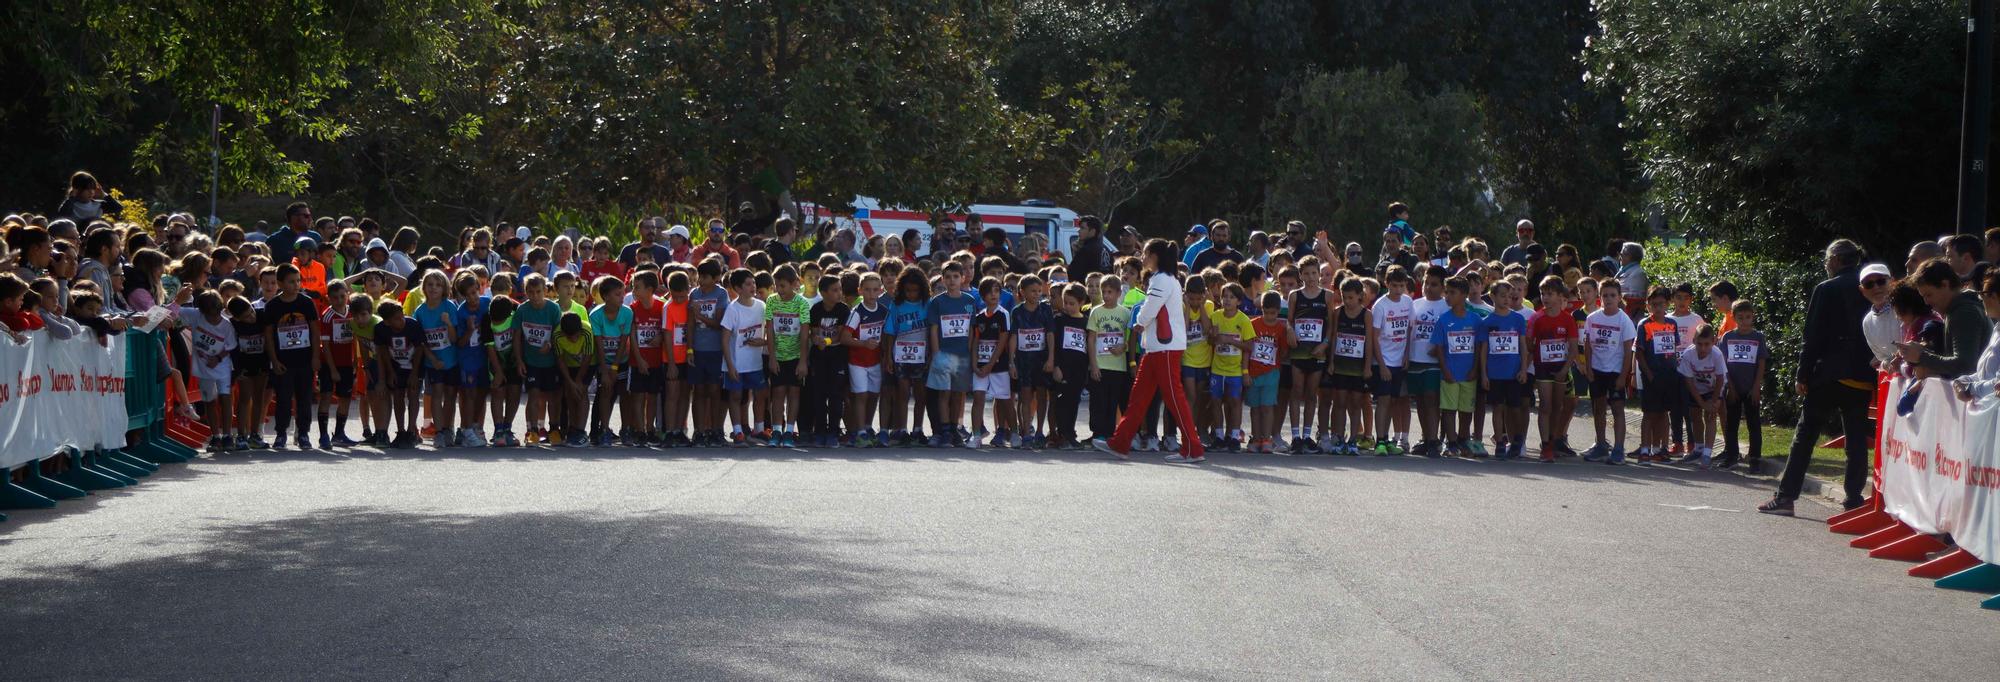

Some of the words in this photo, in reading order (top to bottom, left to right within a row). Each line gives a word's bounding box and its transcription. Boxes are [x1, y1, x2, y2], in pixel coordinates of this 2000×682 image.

[949, 319, 964, 328] 417
[1300, 323, 1316, 331] 404
[867, 327, 880, 336] 472
[1417, 325, 1433, 333] 420
[1597, 329, 1612, 337] 462
[528, 329, 545, 338] 408
[1025, 334, 1040, 342] 402
[1103, 337, 1119, 345] 447
[1455, 336, 1471, 344] 437
[1496, 336, 1512, 344] 474
[1341, 339, 1357, 347] 435
[1257, 344, 1273, 353] 377
[1734, 344, 1751, 352] 398
